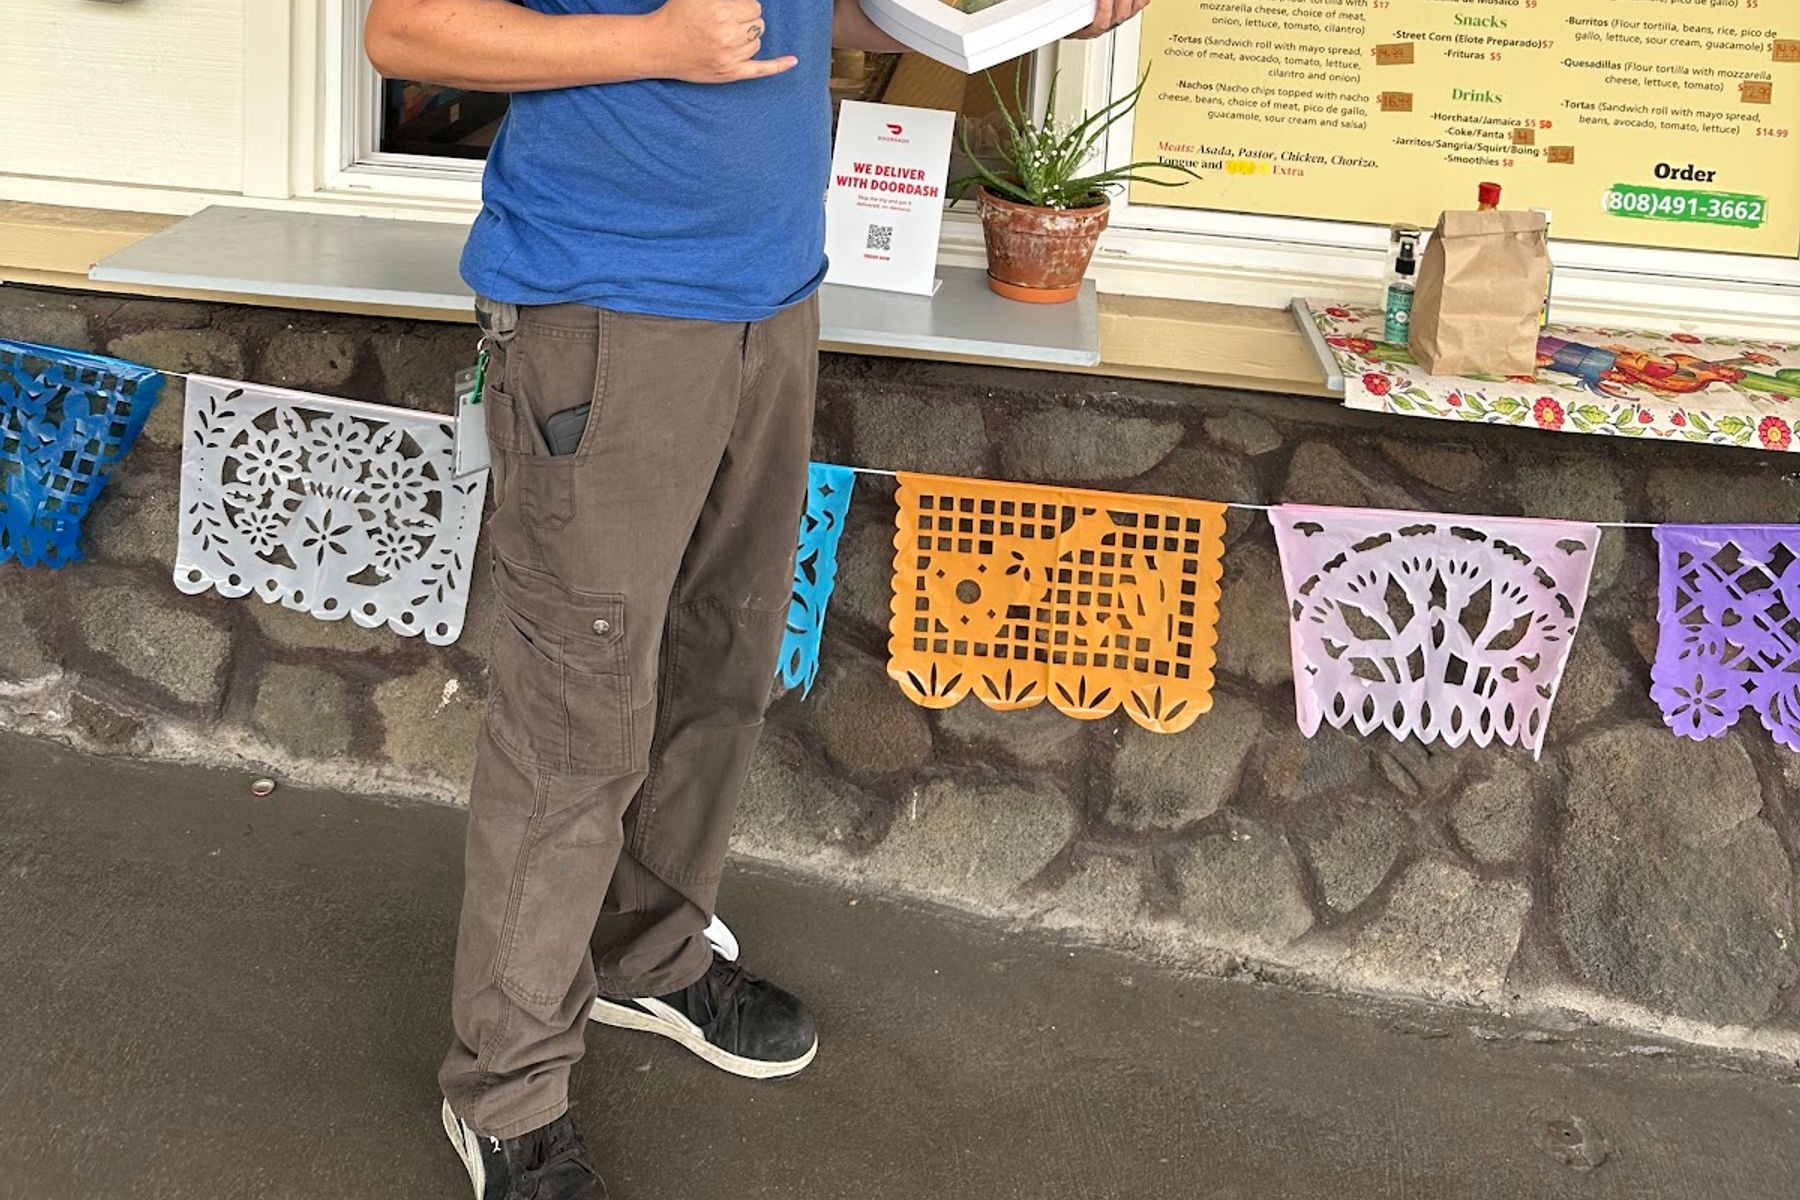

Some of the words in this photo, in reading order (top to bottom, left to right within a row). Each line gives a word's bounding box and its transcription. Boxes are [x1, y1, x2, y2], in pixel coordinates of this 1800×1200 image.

[1199, 2, 1252, 13] mozzarella
[1291, 7, 1323, 18] choice
[1324, 9, 1337, 19] of
[1525, 0, 1537, 9] $9
[1454, 12, 1508, 29] Snacks
[1428, 31, 1452, 42] Corn
[1486, 35, 1542, 48] Preparado)
[1740, 27, 1762, 38] pico
[1763, 28, 1778, 40] de
[1443, 50, 1485, 60] -Frituras
[1452, 87, 1503, 104] Drinks
[1756, 128, 1789, 138] $14.99
[1159, 140, 1194, 153] Meats:
[1197, 144, 1235, 157] Asada,
[1238, 147, 1277, 161] Pastor,
[1280, 151, 1327, 165] Chicken,
[1330, 155, 1378, 168] Chorizo.
[1444, 155, 1500, 167] -Smoothies
[853, 162, 872, 174] WE
[875, 164, 925, 181] DELIVER
[1273, 165, 1305, 177] Extra
[1654, 163, 1716, 183] Order
[837, 175, 868, 189] WITH
[871, 180, 939, 197] DOORDASH
[1602, 191, 1762, 221] (808)491-3662
